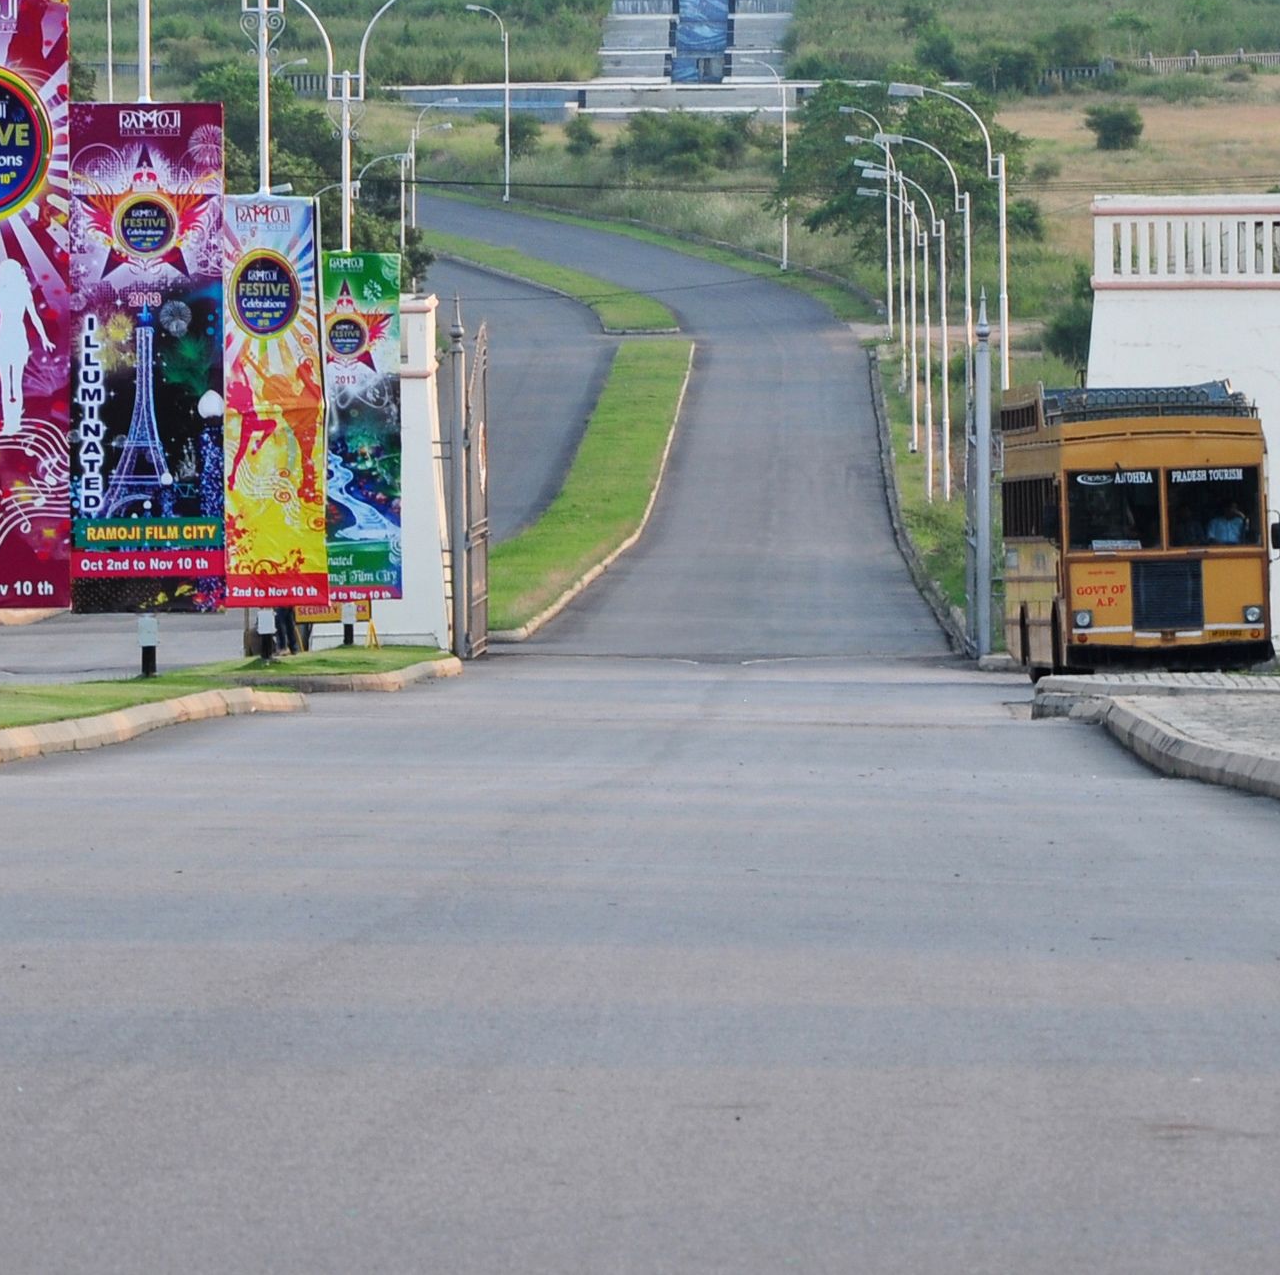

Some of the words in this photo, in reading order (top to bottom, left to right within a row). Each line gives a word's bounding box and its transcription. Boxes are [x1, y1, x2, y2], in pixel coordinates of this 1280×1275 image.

[119, 109, 180, 128] RAMOJI
[235, 205, 290, 222] RAMOJI
[124, 218, 166, 227] FESTIVE
[239, 283, 290, 296] FESTIVE
[128, 292, 162, 306] 2013
[241, 298, 286, 308] Celebrations
[335, 375, 357, 384] 2013
[80, 317, 102, 508] ILLUMINATED
[1114, 471, 1153, 484] ANDHRA
[1172, 469, 1207, 483] PRADESH
[1208, 468, 1243, 481] TOURISM
[87, 526, 140, 541] RAMOJI
[145, 525, 179, 540] FILM
[183, 525, 216, 539] CITY
[81, 558, 103, 570] Oct
[106, 558, 129, 570] 2nd
[133, 559, 146, 570] to
[150, 558, 173, 570] Nov
[177, 558, 192, 569] 10
[196, 557, 208, 569] th
[14, 581, 33, 595] 10
[37, 580, 53, 595] th
[232, 586, 251, 597] 2nd
[254, 586, 266, 597] to
[270, 585, 288, 596] Nov
[291, 585, 303, 596] 10
[306, 584, 317, 596] th
[1076, 585, 1107, 595] GOVT
[1111, 584, 1126, 594] OF
